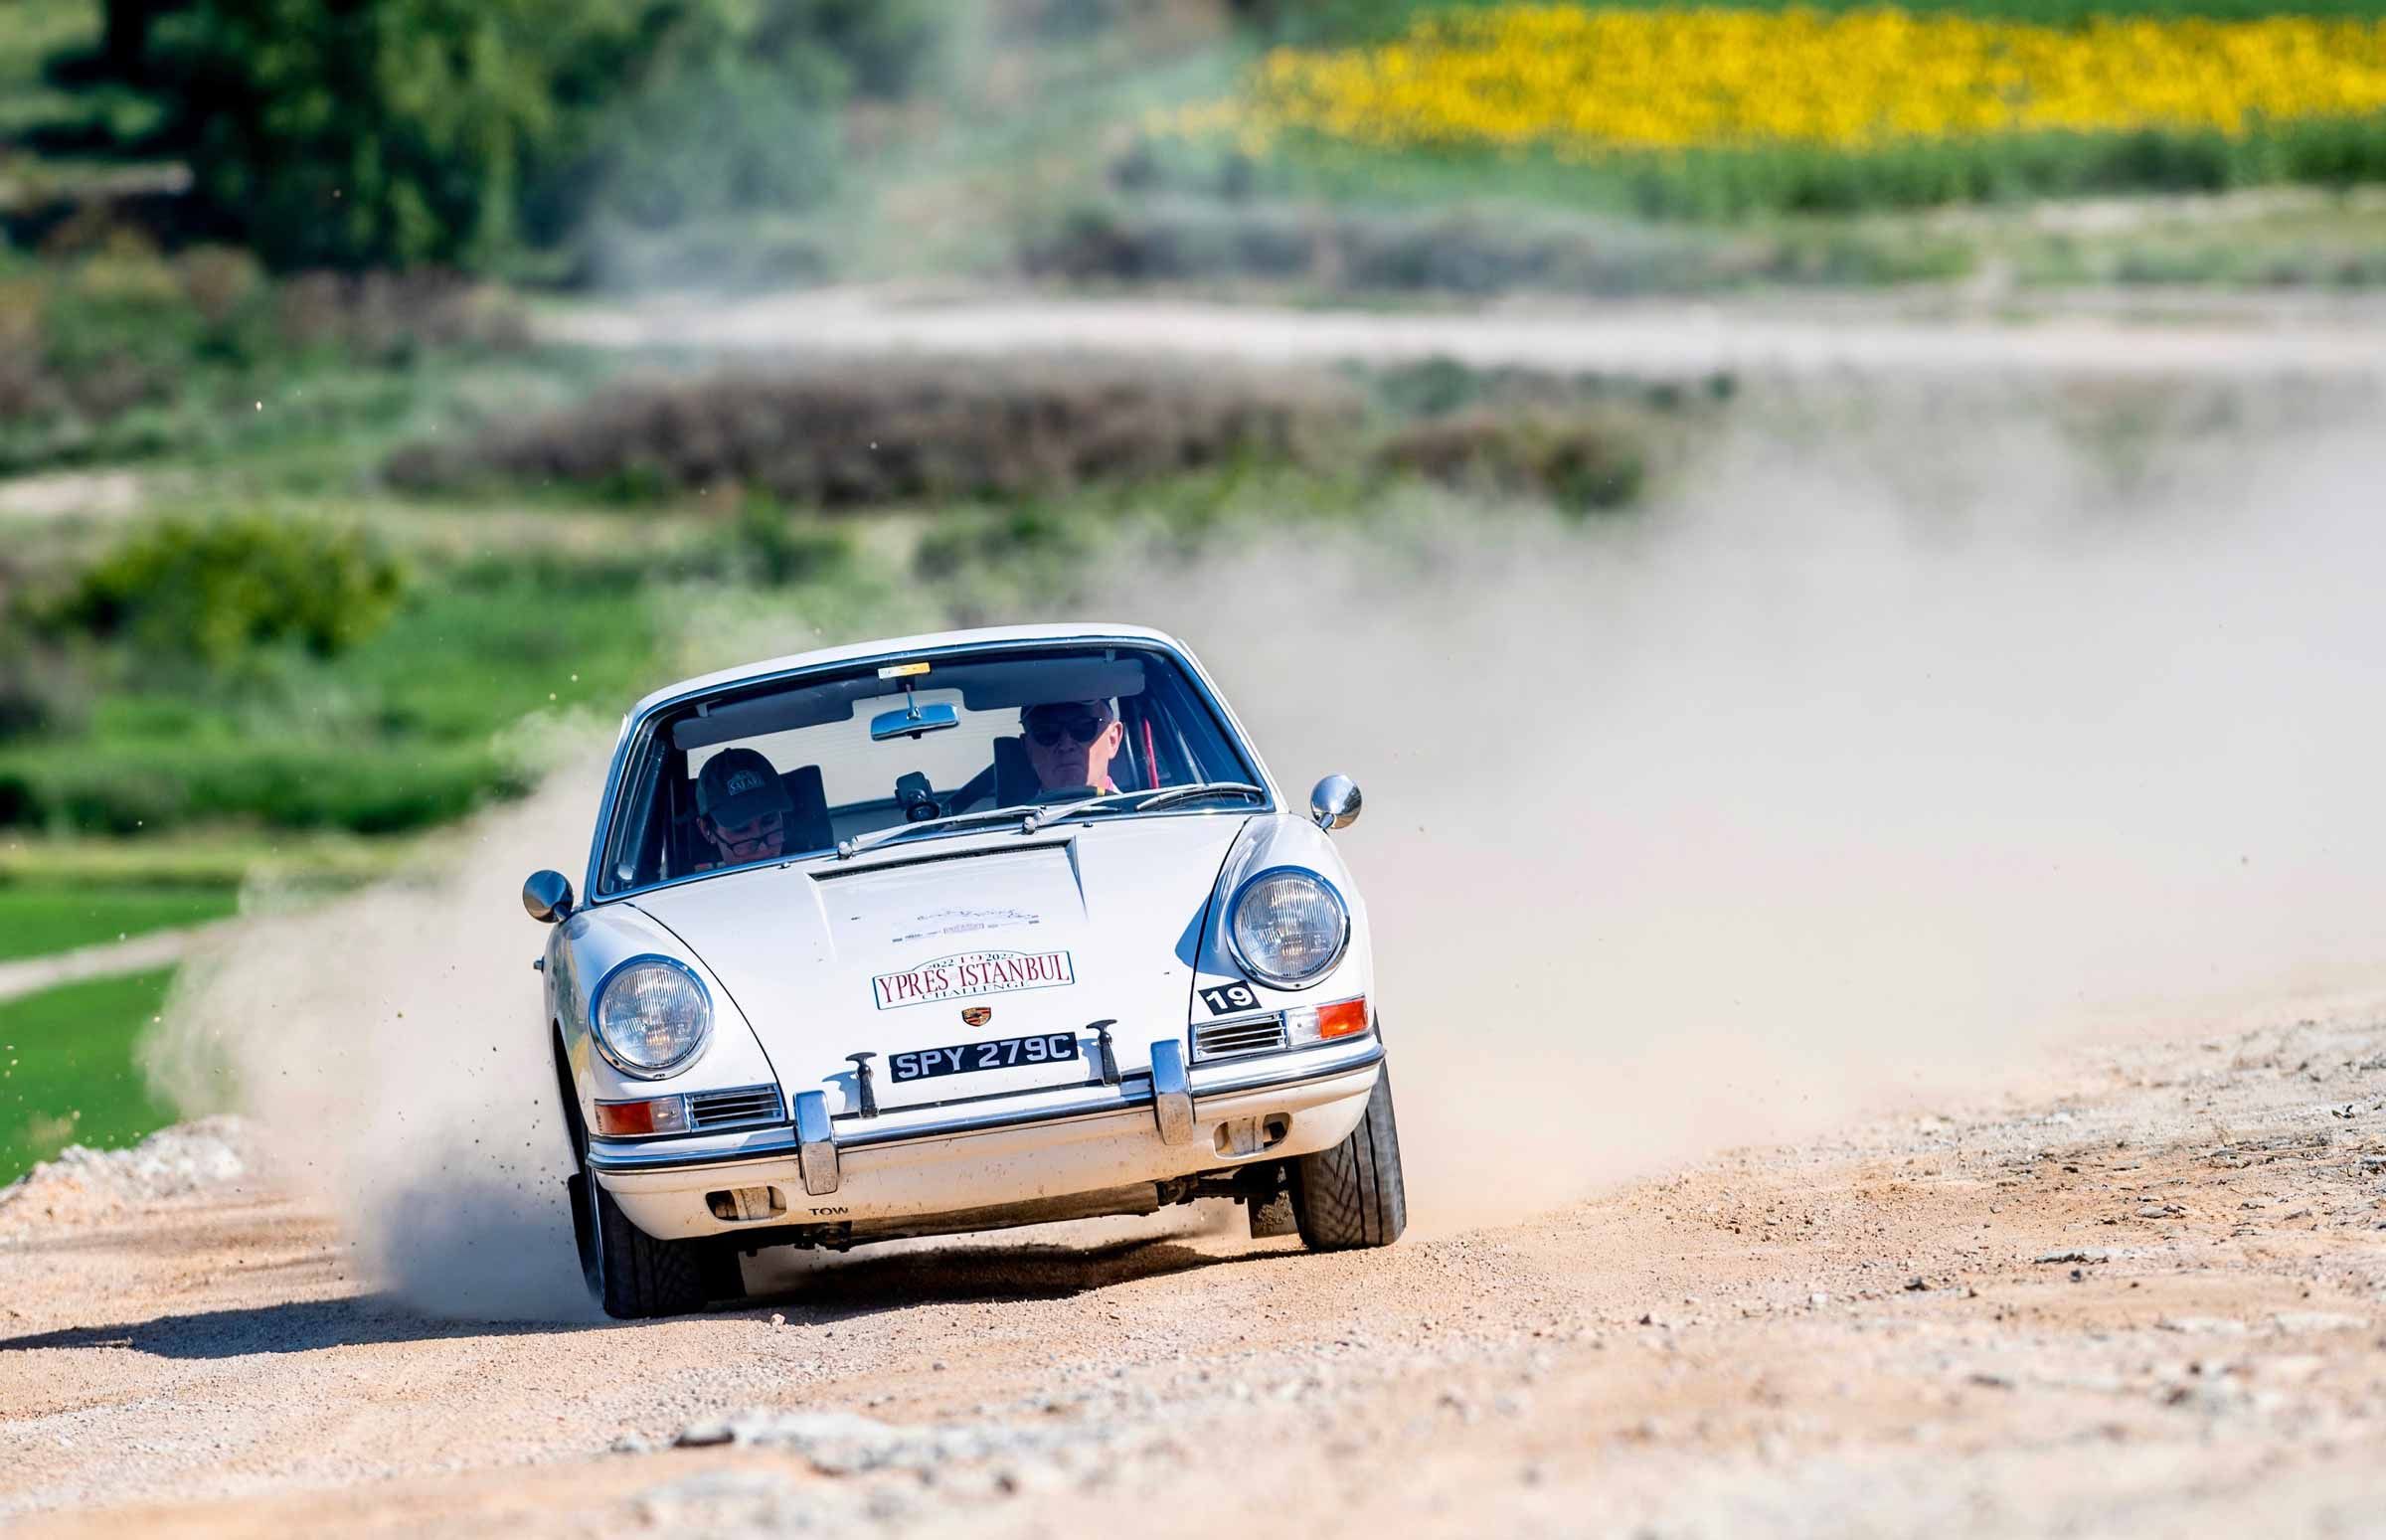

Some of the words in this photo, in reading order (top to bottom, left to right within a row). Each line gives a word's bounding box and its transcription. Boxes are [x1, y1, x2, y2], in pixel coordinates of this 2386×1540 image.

[879, 968, 949, 1004] YPRES
[957, 954, 1070, 988] ISTANBUL
[1206, 986, 1254, 1010] 19
[897, 1046, 965, 1079] SPY
[976, 1034, 1072, 1068] 279C
[808, 1206, 849, 1216] TOW
